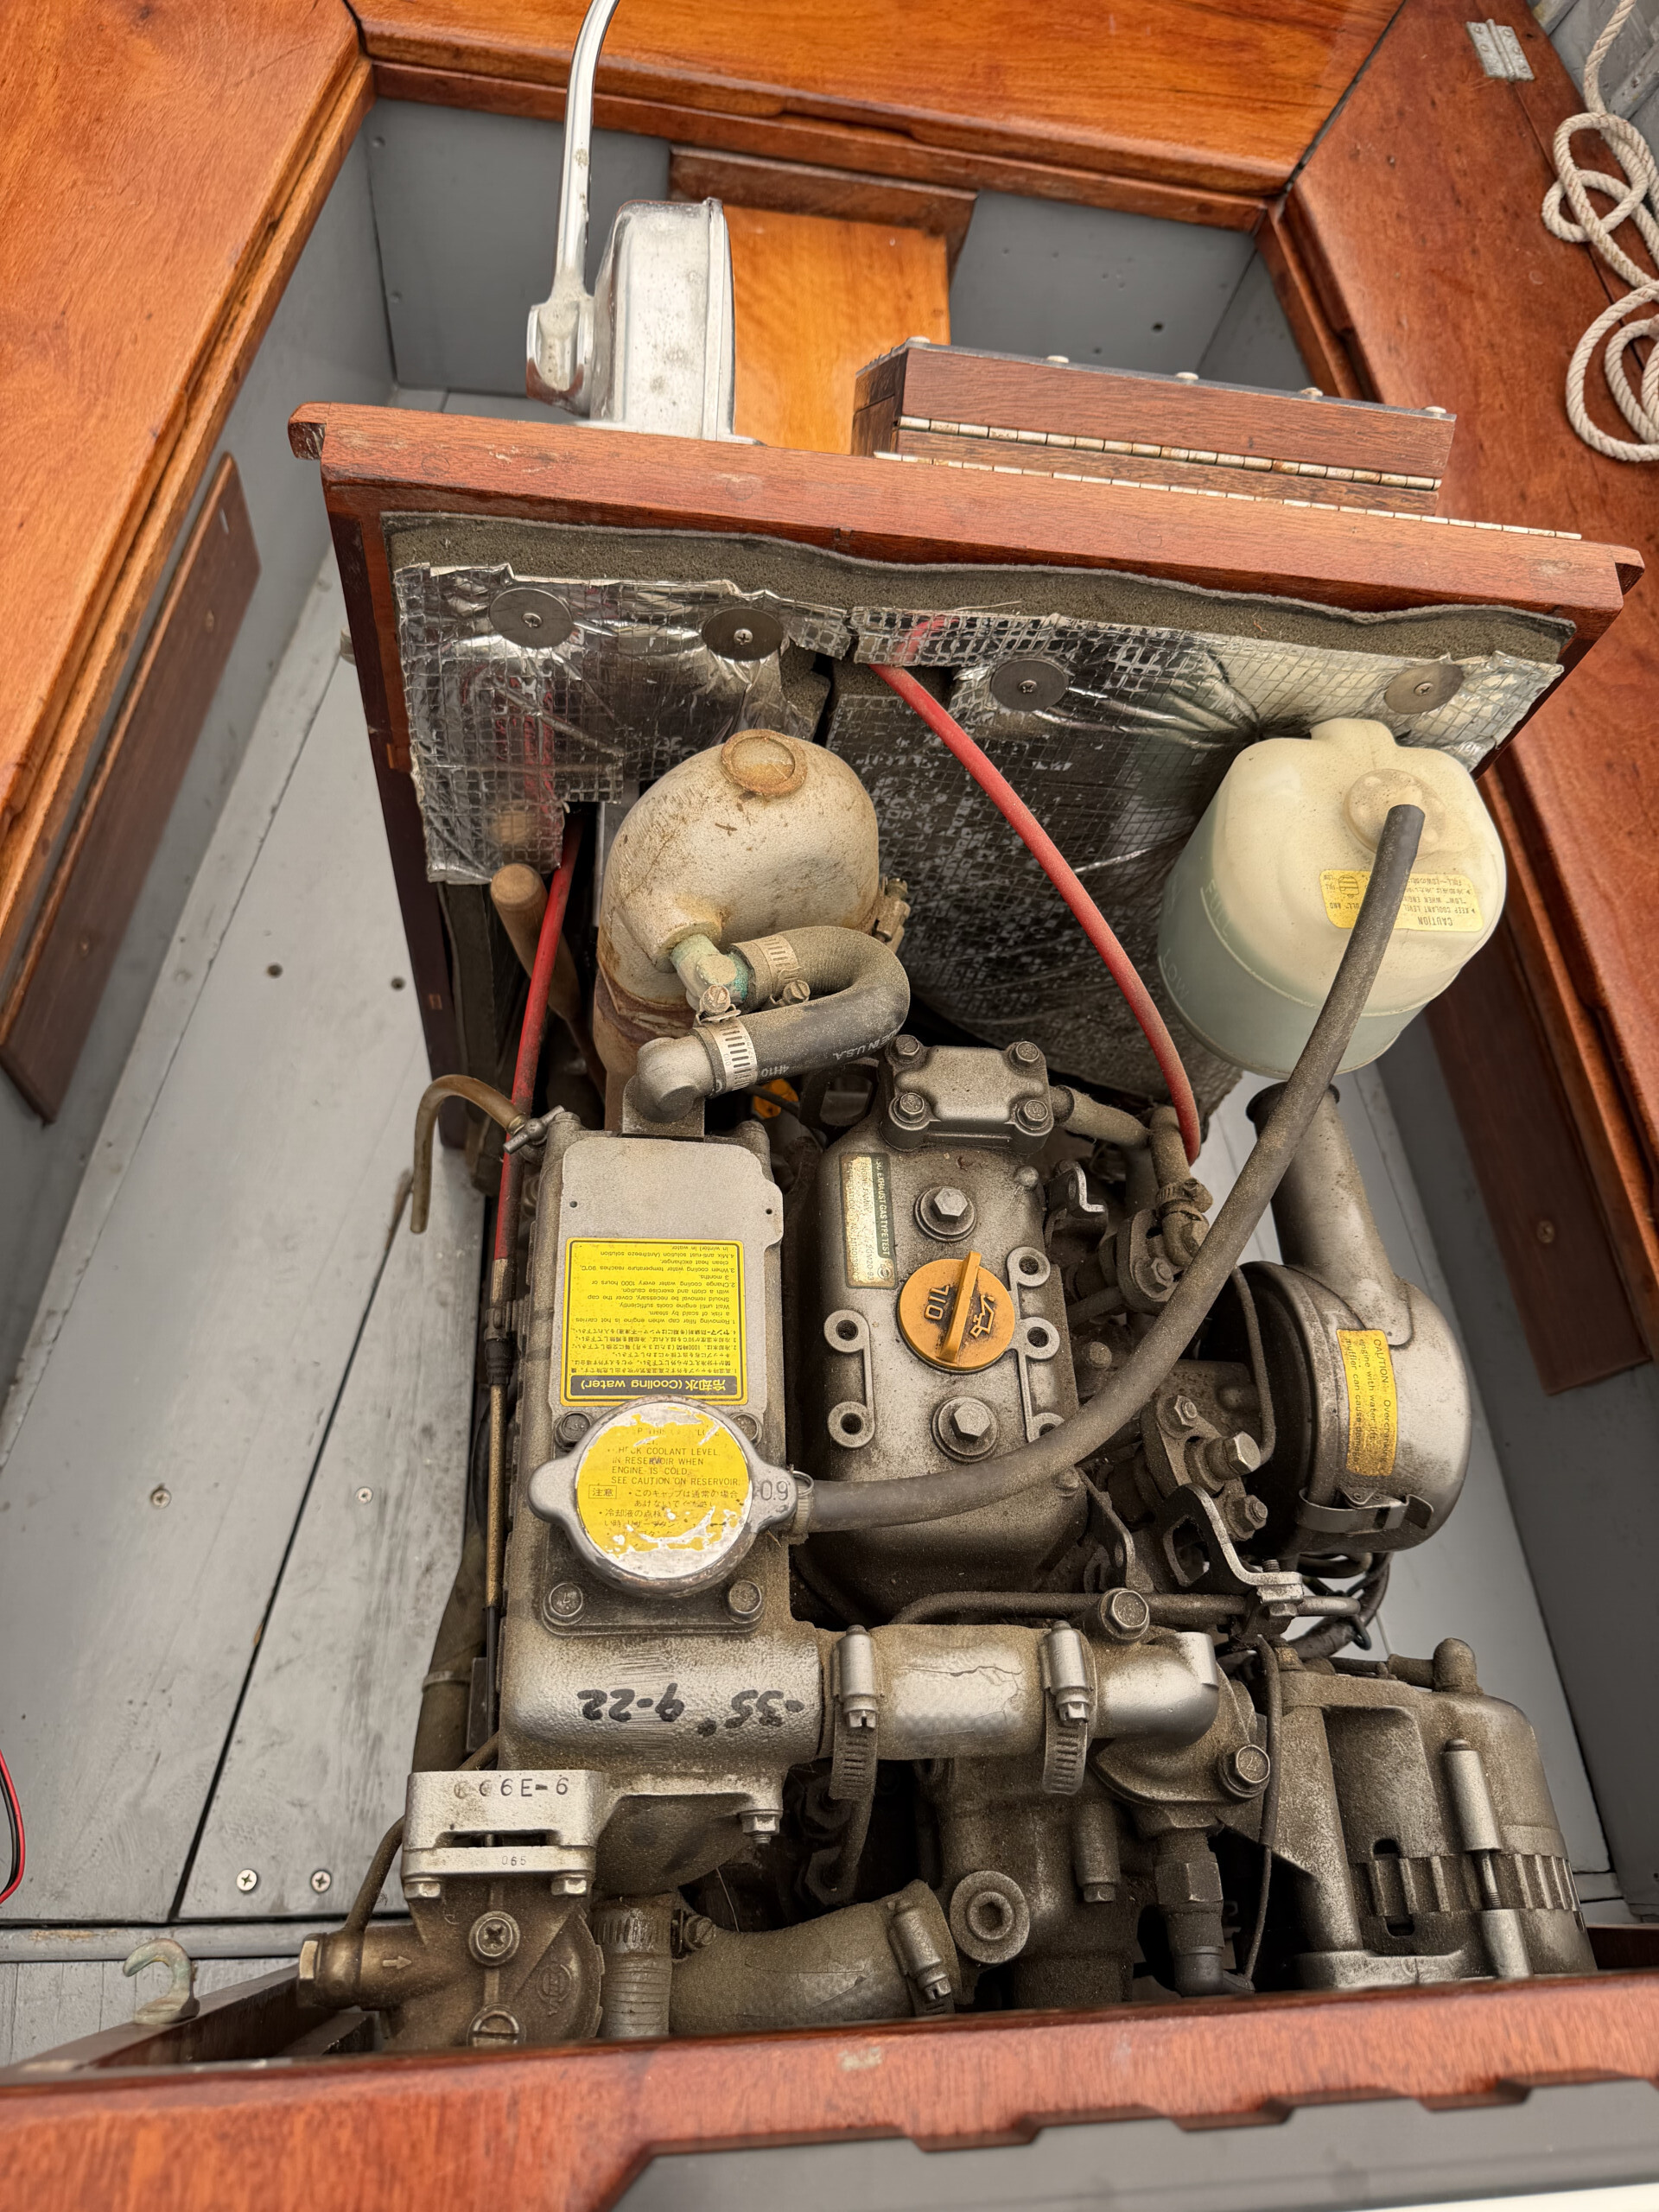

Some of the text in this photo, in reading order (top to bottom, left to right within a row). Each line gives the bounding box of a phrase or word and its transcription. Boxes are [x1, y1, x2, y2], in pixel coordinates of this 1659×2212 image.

[1417, 917, 1452, 925] CAUTION
[876, 1173, 886, 1203] EXHAUST
[881, 1238, 890, 1255] TEST
[925, 1286, 949, 1320] OIL
[1345, 1338, 1358, 1370] muffler
[1352, 1374, 1361, 1391] can
[1358, 1338, 1371, 1368] engine
[1367, 1371, 1376, 1391] with
[581, 1379, 726, 1391] 冷却水 (Cooling water)
[592, 1488, 613, 1497] 注意
[760, 1480, 788, 1501] 0.9
[576, 1682, 684, 1723] 9-22
